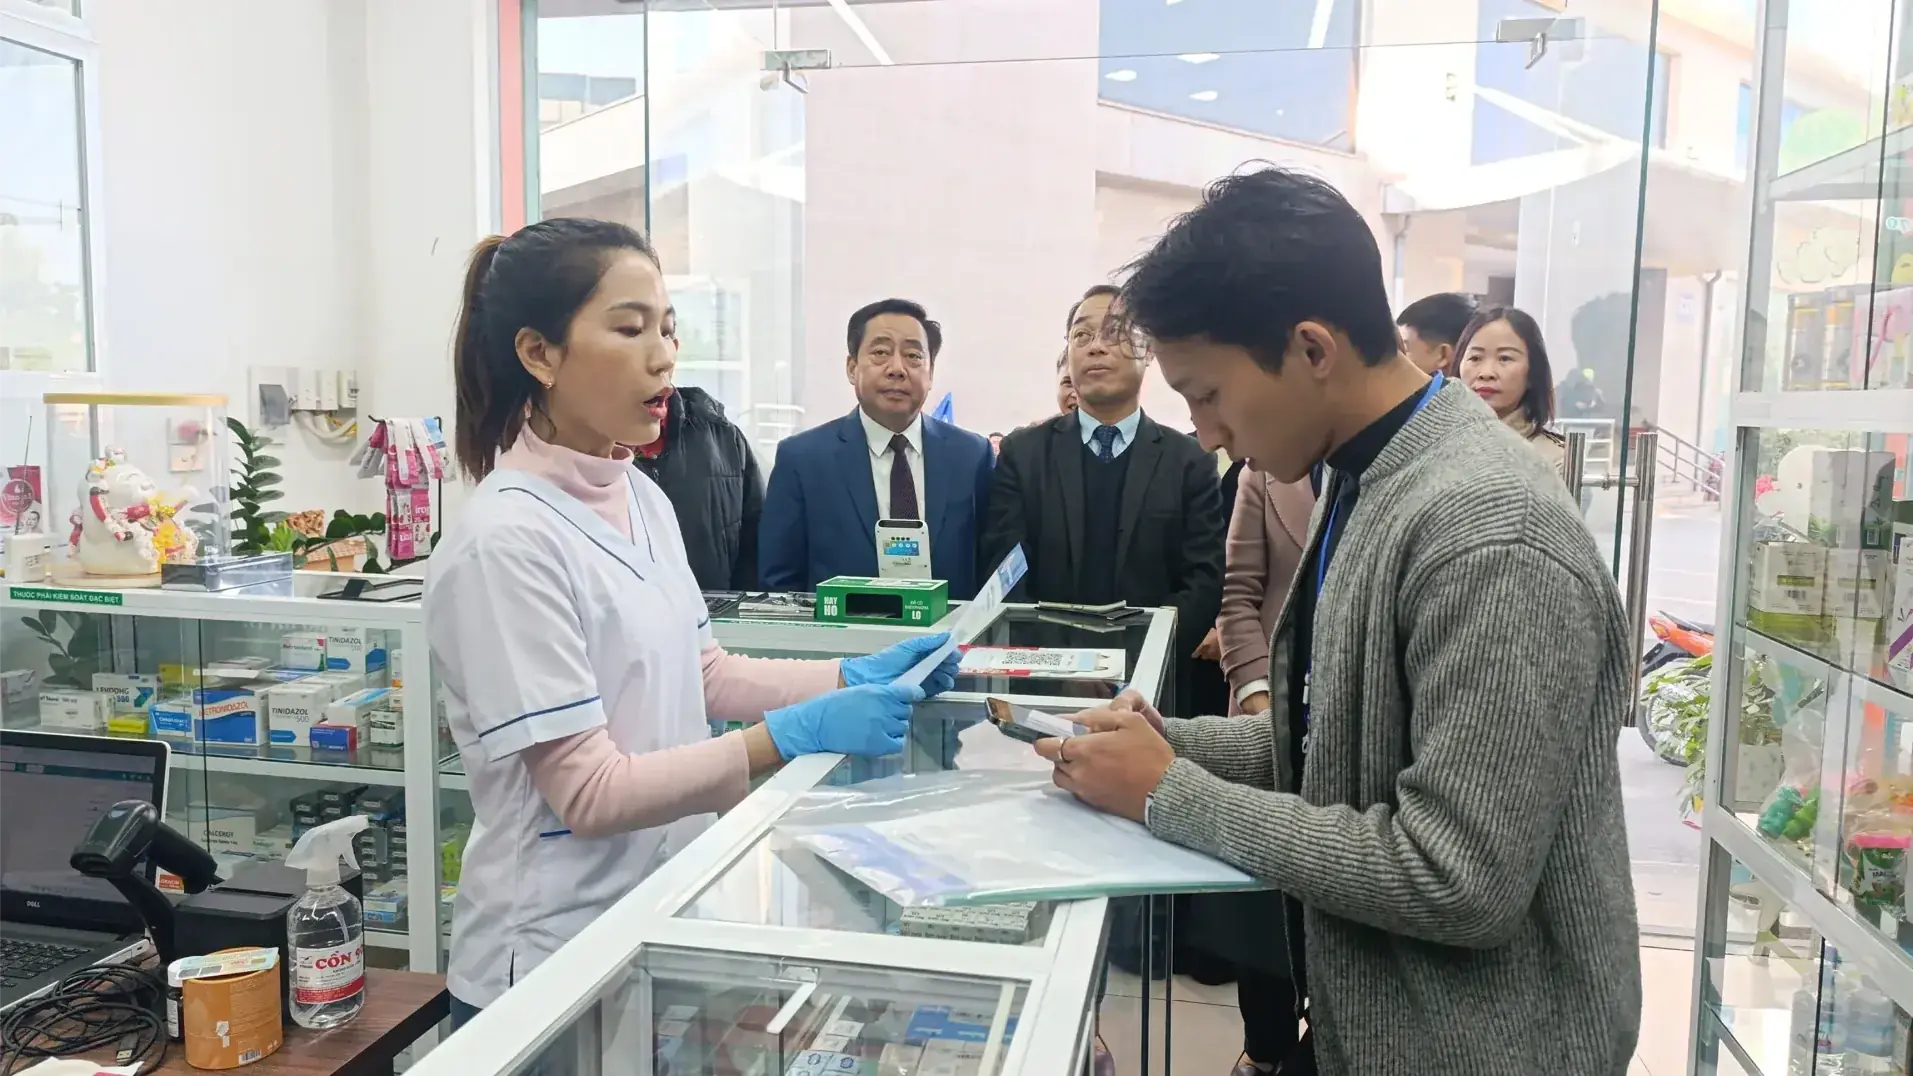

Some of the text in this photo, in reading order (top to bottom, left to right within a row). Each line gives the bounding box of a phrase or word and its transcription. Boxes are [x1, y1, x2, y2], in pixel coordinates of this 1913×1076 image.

[824, 596, 838, 605] HAY
[824, 605, 838, 616] HO
[329, 636, 363, 645] TINIDAZOL
[271, 707, 309, 716] TINIDAZOL
[26, 900, 41, 908] DELL
[315, 950, 352, 970] CỒN
